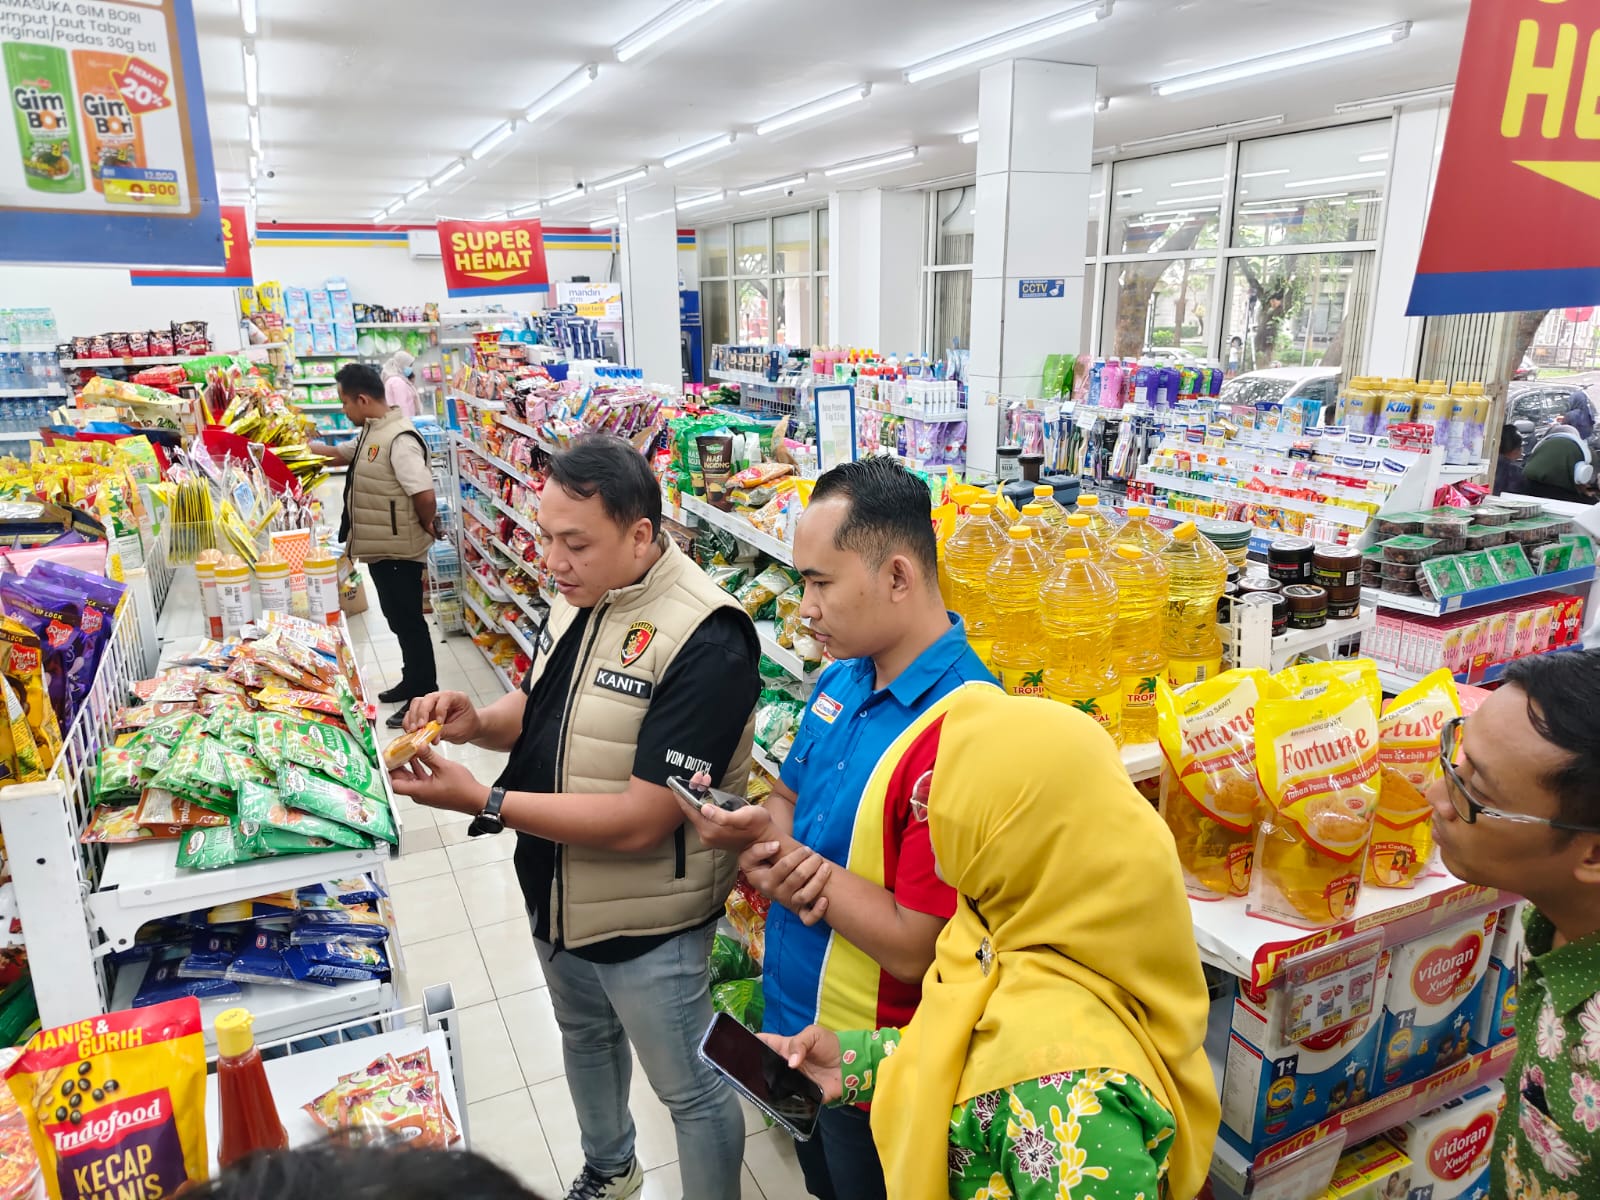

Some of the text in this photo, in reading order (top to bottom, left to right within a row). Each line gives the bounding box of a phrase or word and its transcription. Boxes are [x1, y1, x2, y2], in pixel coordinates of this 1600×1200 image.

[52, 15, 86, 30] Laut
[90, 20, 132, 36] Tabur
[76, 4, 105, 18] GIM
[109, 8, 141, 24] BORI
[107, 37, 135, 54] 30g
[138, 41, 157, 53] btl
[128, 63, 165, 88] HEMAT
[14, 87, 64, 111] Gim
[120, 77, 163, 108] 20%
[83, 94, 129, 117] Gim
[28, 110, 68, 129] Bori
[95, 116, 133, 135] Bori
[451, 229, 532, 252] SUPER
[453, 250, 533, 271] HEMAT
[1022, 283, 1048, 293] CCTV
[1386, 401, 1412, 414] Klin
[44, 612, 63, 620] LOCK
[596, 670, 646, 695] KANIT
[1013, 686, 1044, 695] TROPI
[665, 748, 713, 774] VON DUTCH
[1280, 727, 1370, 775] Fortune
[1287, 787, 1309, 801] Tahan
[1418, 947, 1474, 982] vidoran
[1420, 968, 1462, 996] Xmart
[27, 1019, 109, 1053] MANIS &
[1344, 1020, 1366, 1039] milk
[78, 1026, 143, 1059] GURIH
[1277, 1059, 1295, 1077] 1+
[53, 1098, 162, 1150] Indofood
[1434, 1125, 1487, 1161] vidoran
[73, 1143, 153, 1195] KECAP
[1442, 1145, 1476, 1174] Xmart
